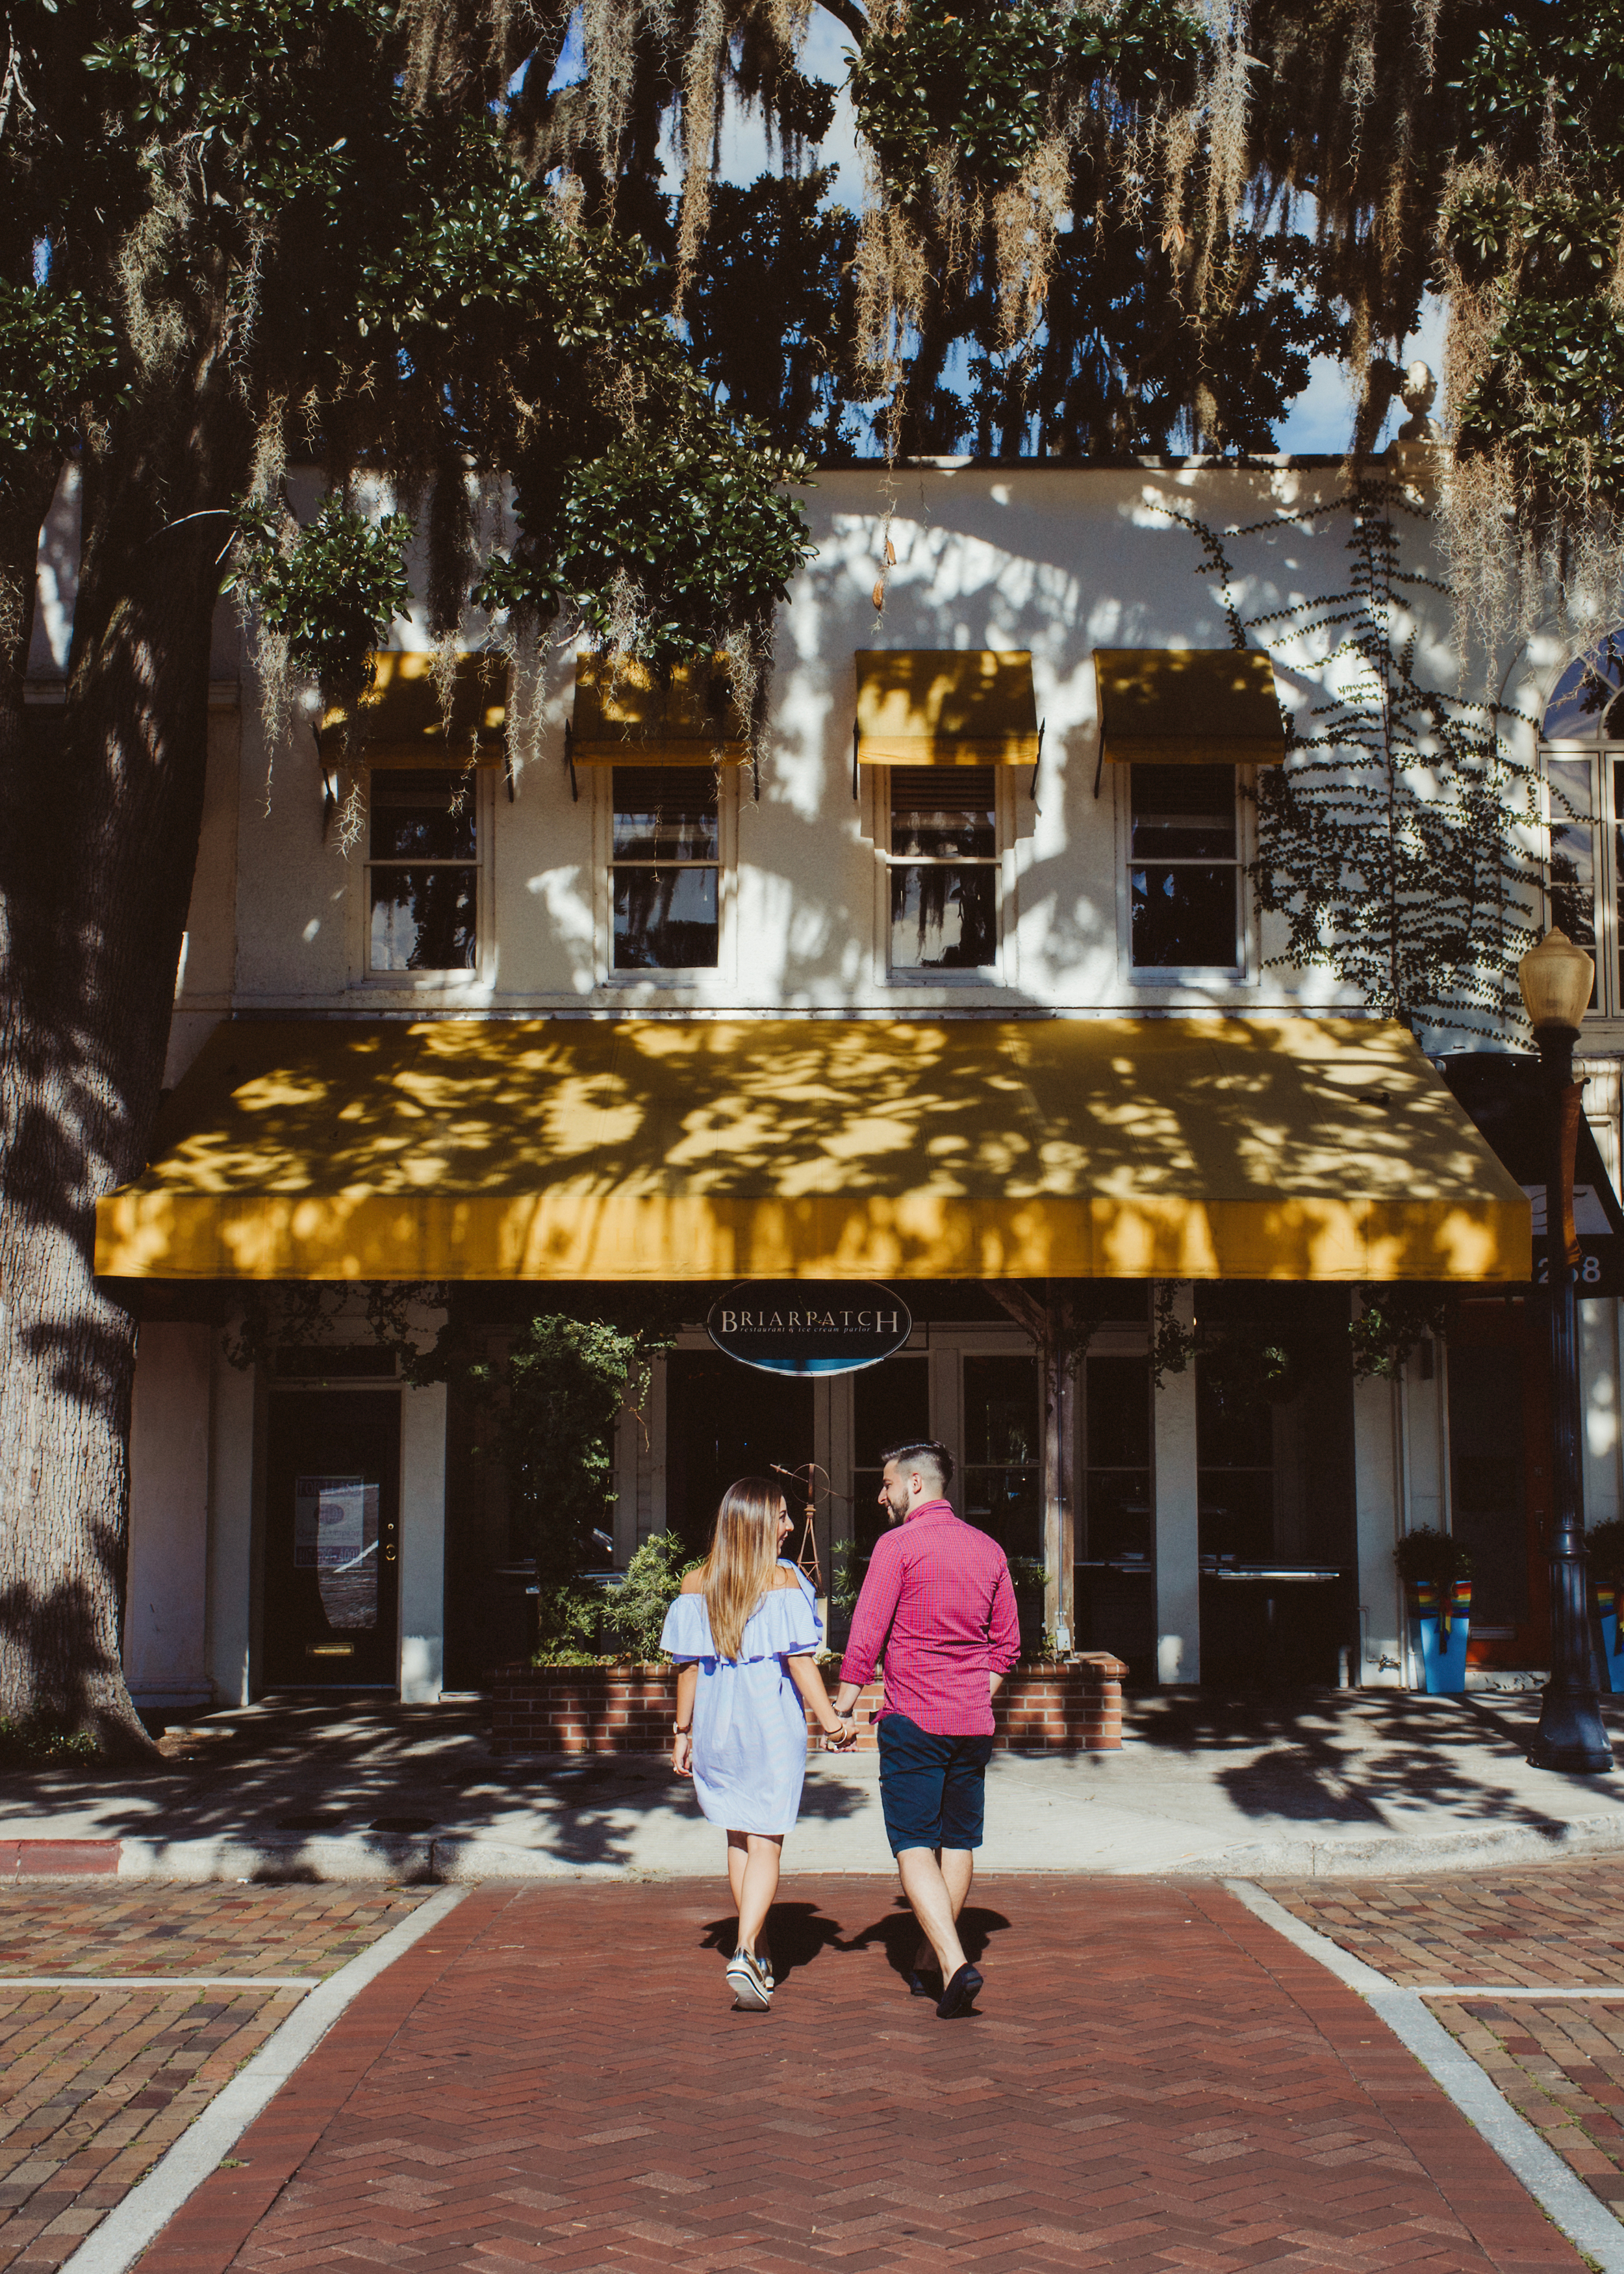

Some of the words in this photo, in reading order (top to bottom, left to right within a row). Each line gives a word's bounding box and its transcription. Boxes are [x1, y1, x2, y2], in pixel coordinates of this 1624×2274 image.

[1538, 1257, 1601, 1284] 28
[720, 1310, 899, 1333] BRIARPATCH
[843, 1325, 870, 1334] parlor
[299, 1481, 320, 1495] FOR
[324, 1481, 360, 1496] LEASE
